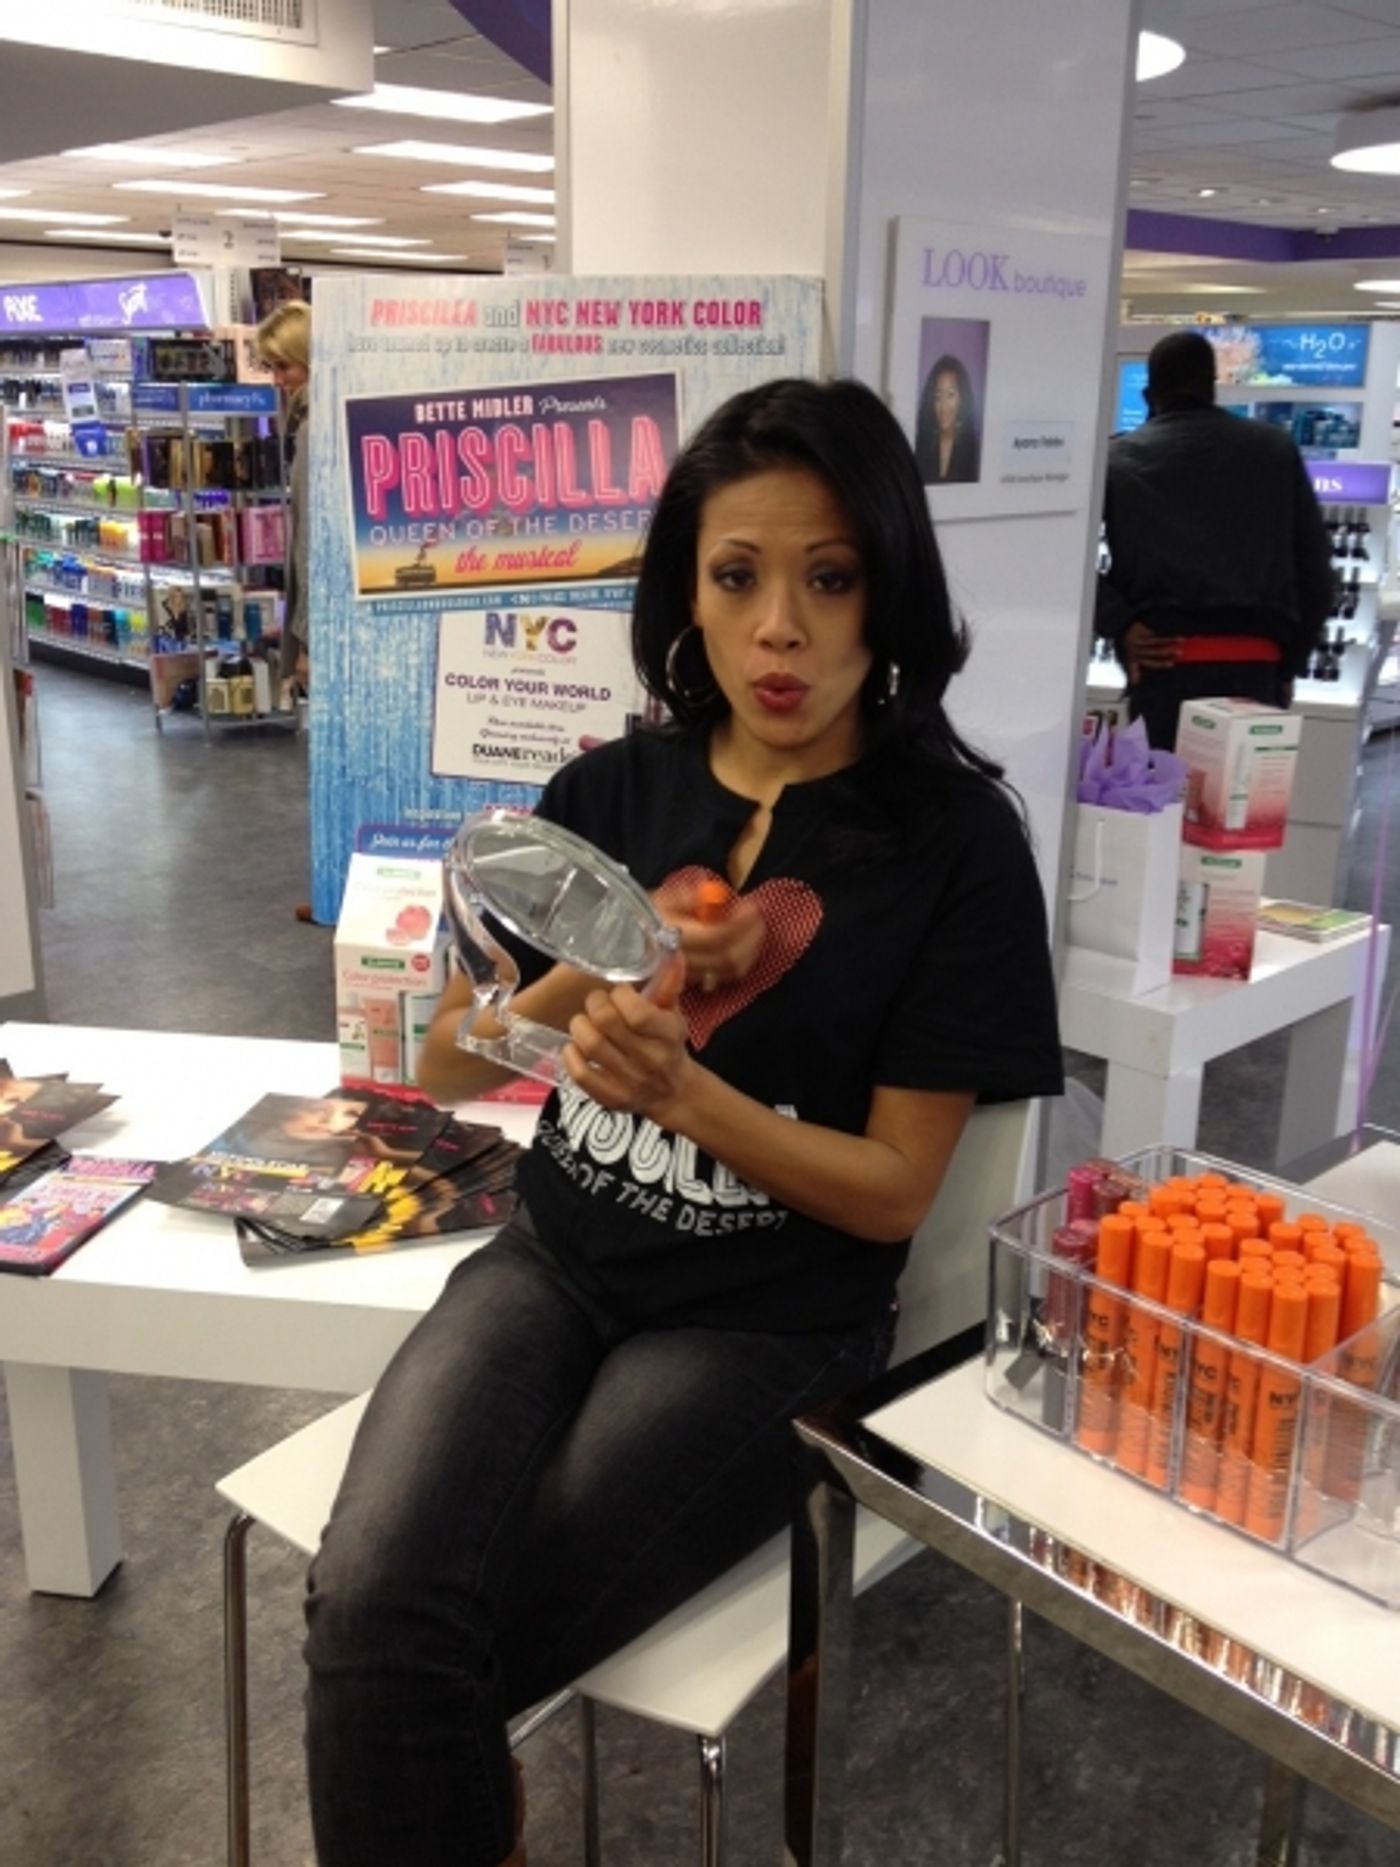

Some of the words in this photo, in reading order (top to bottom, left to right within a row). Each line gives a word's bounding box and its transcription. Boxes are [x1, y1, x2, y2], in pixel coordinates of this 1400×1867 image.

[922, 247, 1010, 292] LOOK
[1014, 268, 1087, 299] boutique
[370, 298, 477, 327] PRISCILLA
[484, 300, 519, 328] and
[526, 299, 570, 327] NYC
[576, 299, 620, 327] NEW
[629, 299, 685, 326] YORK
[692, 298, 762, 326] COLOR
[531, 333, 604, 355] FABULOUS
[415, 399, 468, 424] BETTE
[472, 395, 534, 419] MIDLER
[360, 415, 670, 523] PRISCILLA
[370, 521, 456, 546] QUEEN
[466, 518, 498, 541] OF
[510, 515, 557, 537] THE
[568, 509, 652, 535] DESE
[455, 544, 487, 574] the
[492, 539, 582, 572] musical
[484, 612, 578, 655] NYC
[444, 671, 499, 691] COLOR
[504, 677, 550, 696] YOUR
[553, 683, 612, 702] WORLD
[530, 698, 587, 714] MAKEUP
[579, 1162, 617, 1196] OF
[615, 1181, 674, 1223] THE
[1268, 1390, 1299, 1409] NY
